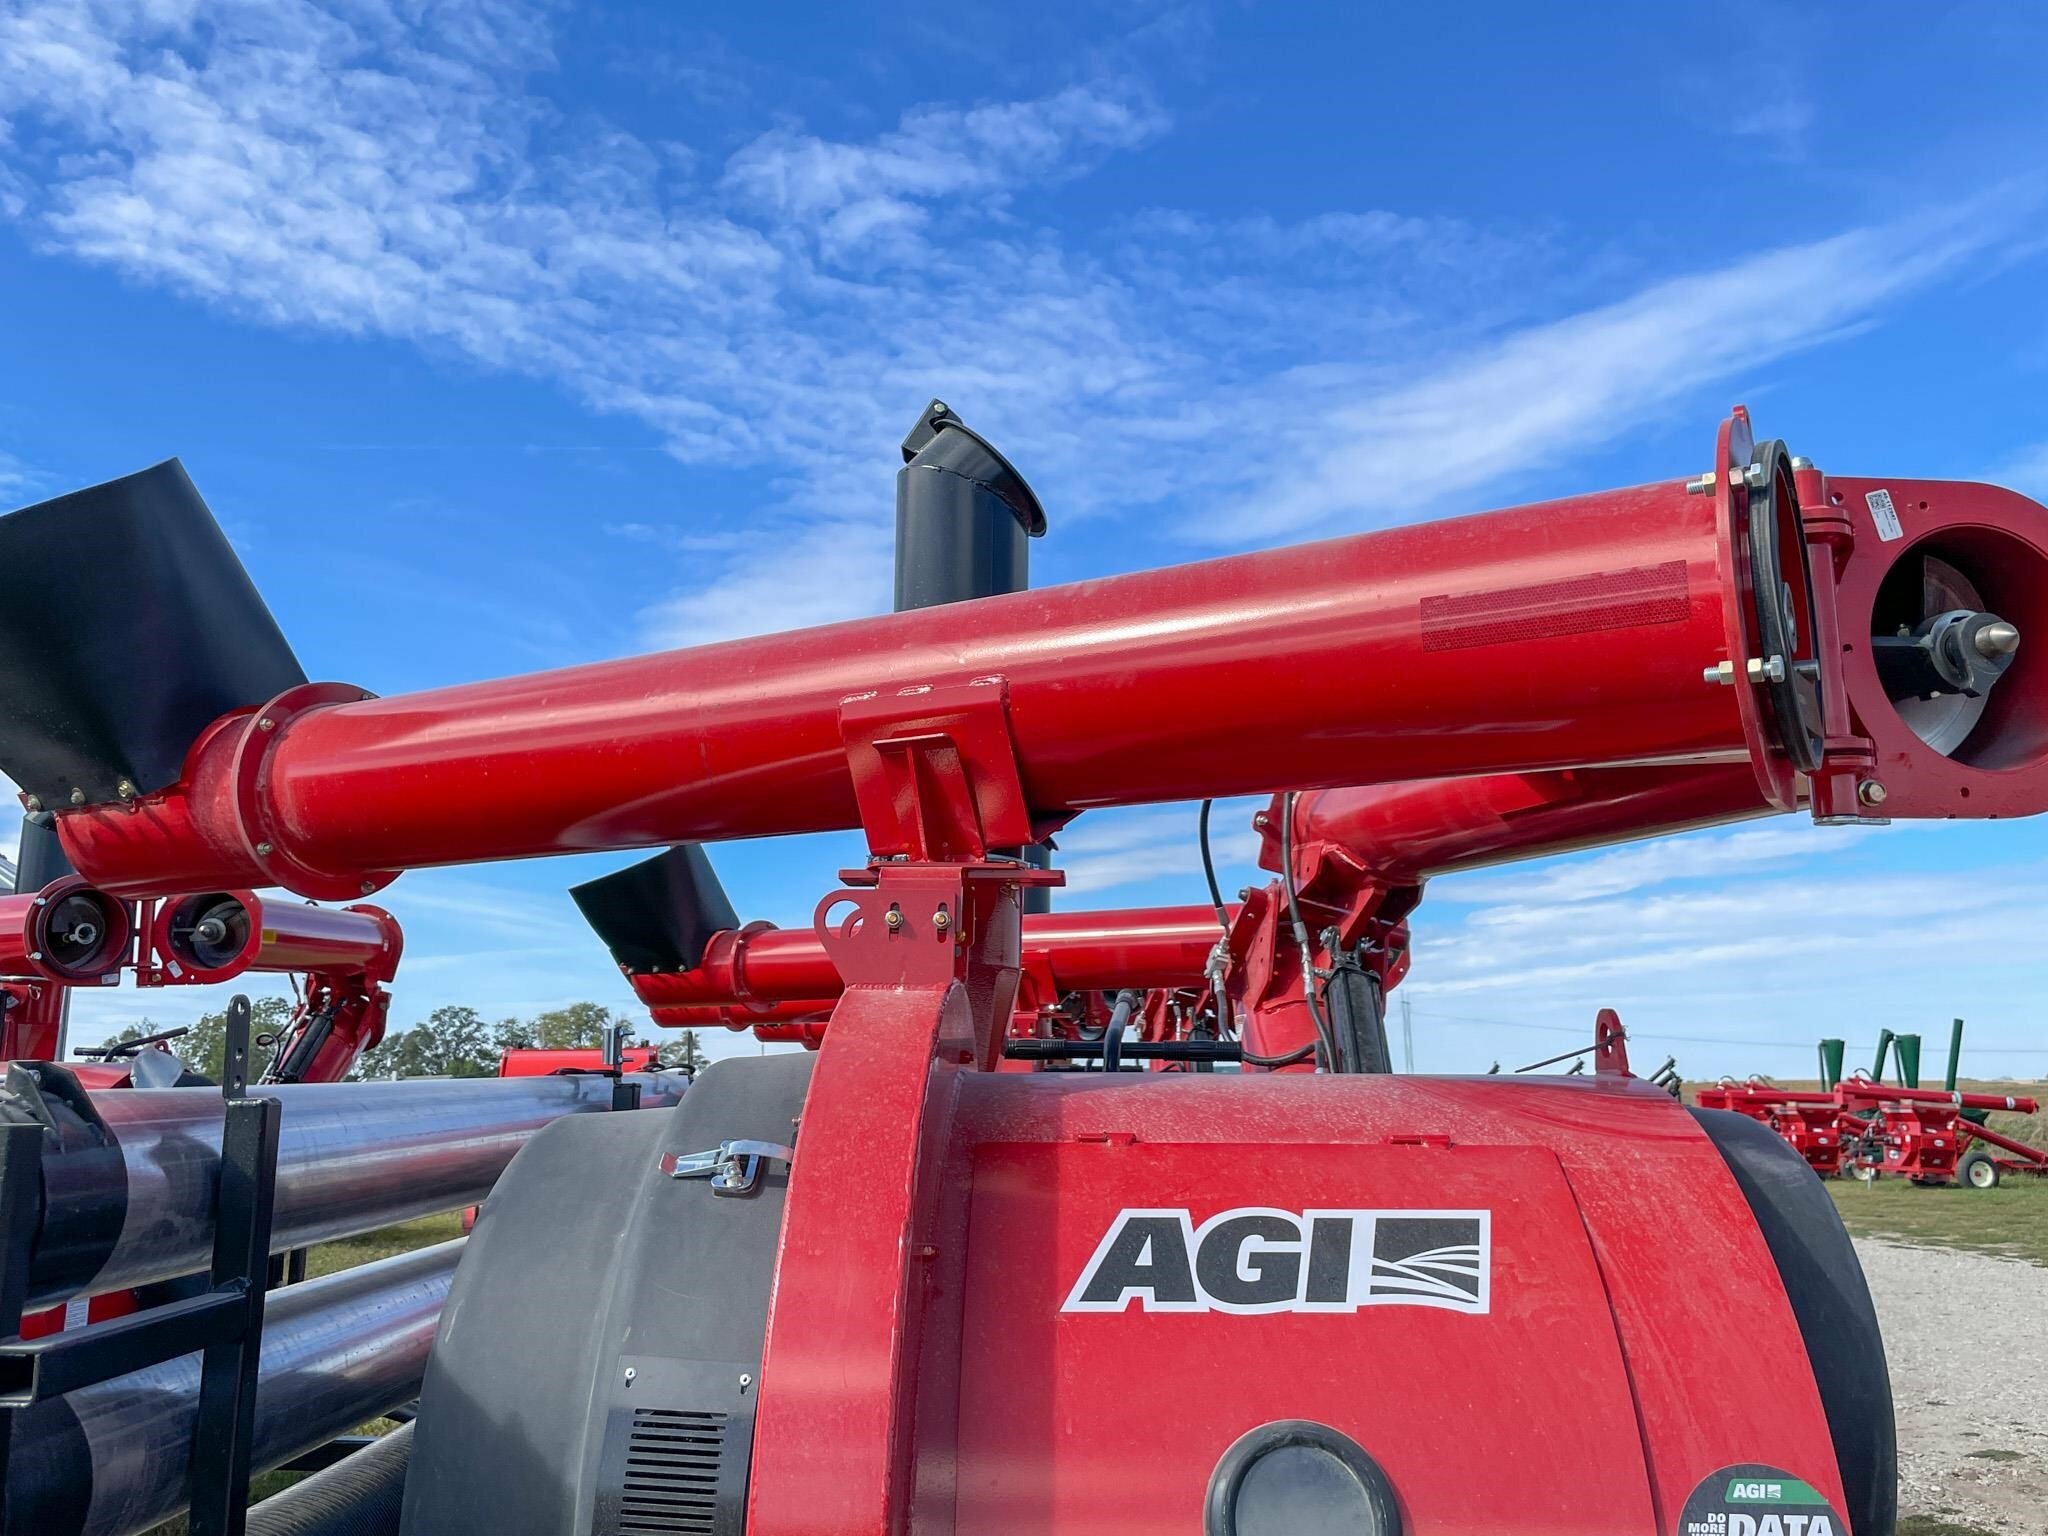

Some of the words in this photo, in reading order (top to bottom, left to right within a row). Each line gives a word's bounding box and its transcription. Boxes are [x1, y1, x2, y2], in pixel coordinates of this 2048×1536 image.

[1074, 1213, 1355, 1306] AGI
[1732, 1483, 1766, 1499] AGI
[1707, 1512, 1727, 1524] DO
[1728, 1513, 1834, 1536] DATA
[1687, 1522, 1726, 1534] MORE
